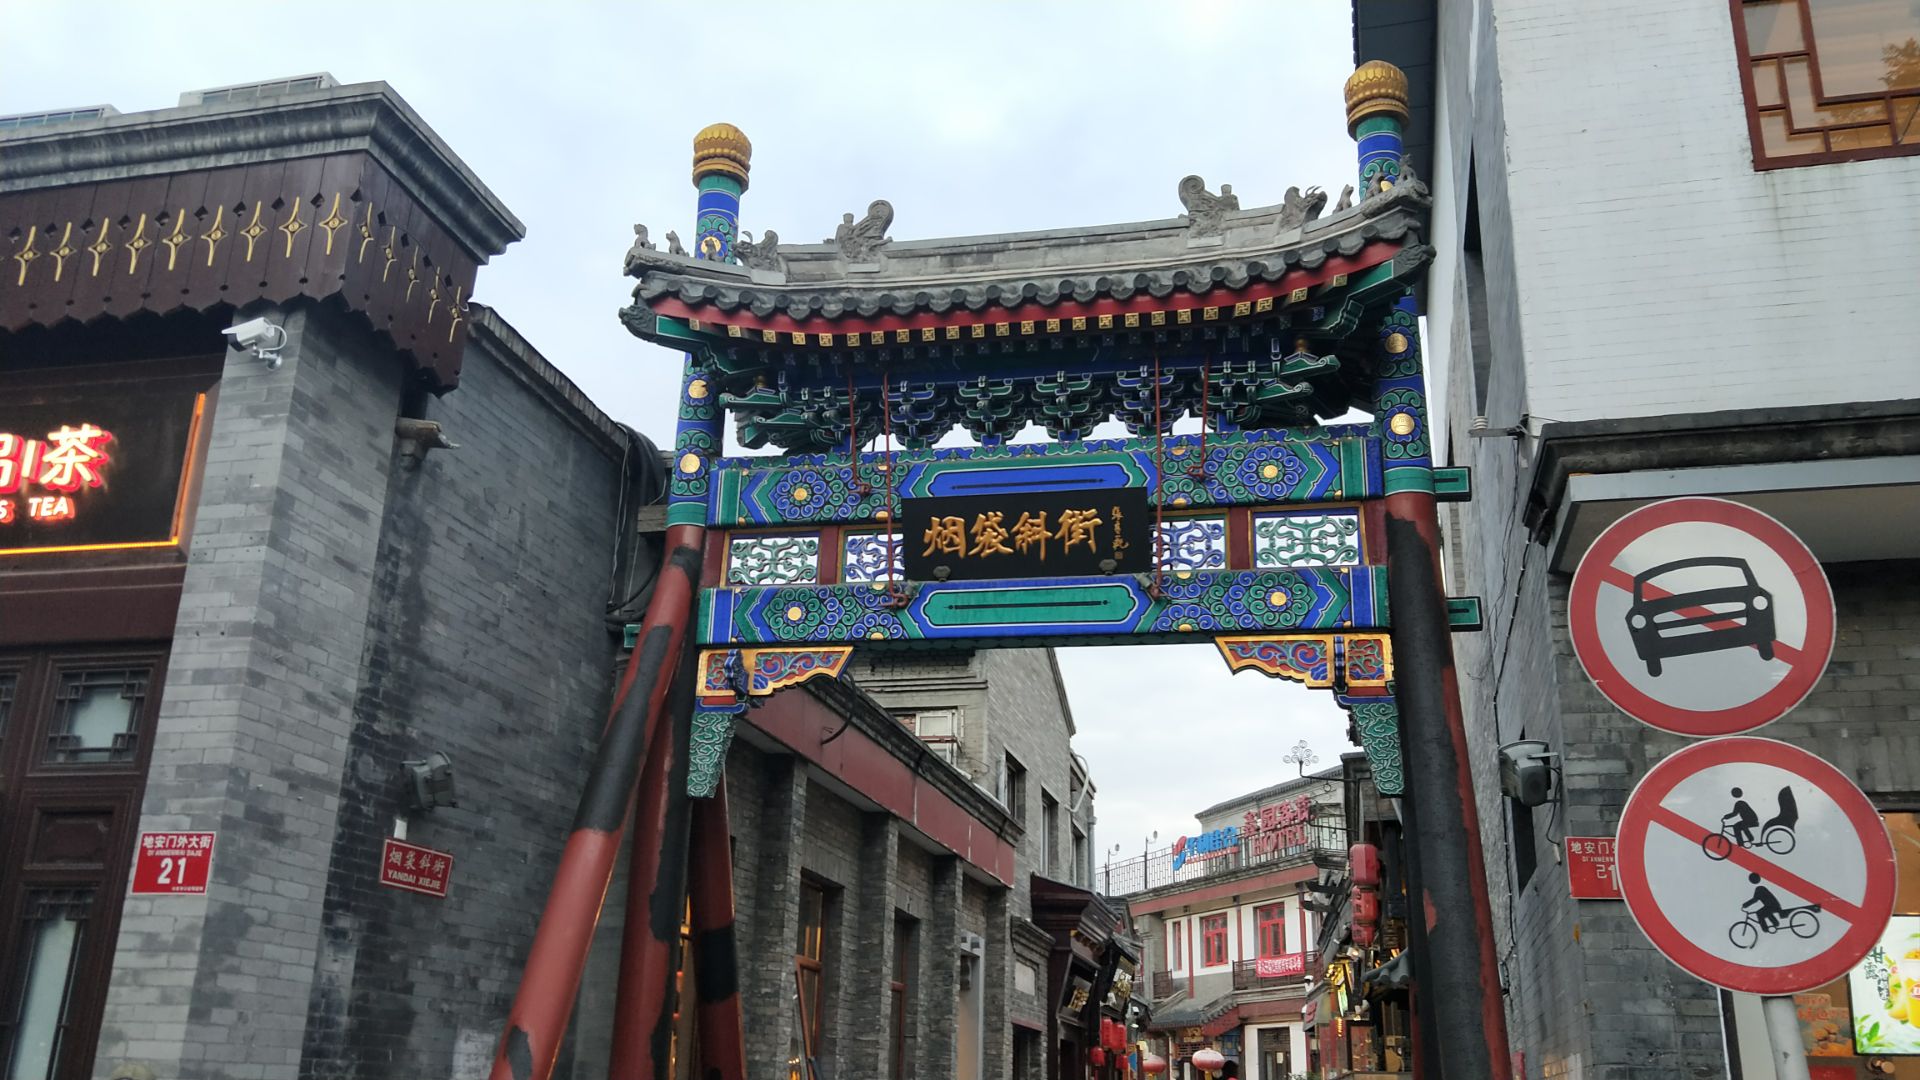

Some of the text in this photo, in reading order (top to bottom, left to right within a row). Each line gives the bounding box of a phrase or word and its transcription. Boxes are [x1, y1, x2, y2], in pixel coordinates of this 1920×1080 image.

[29, 497, 74, 520] TEA
[922, 508, 1103, 561] 烟袋斜街
[143, 835, 211, 849] 地安门外大街
[1252, 825, 1307, 856] HOTEL
[157, 857, 187, 884] 21
[388, 847, 446, 878] 烟袋斜街
[387, 869, 441, 889] YANDAI XIEJIE
